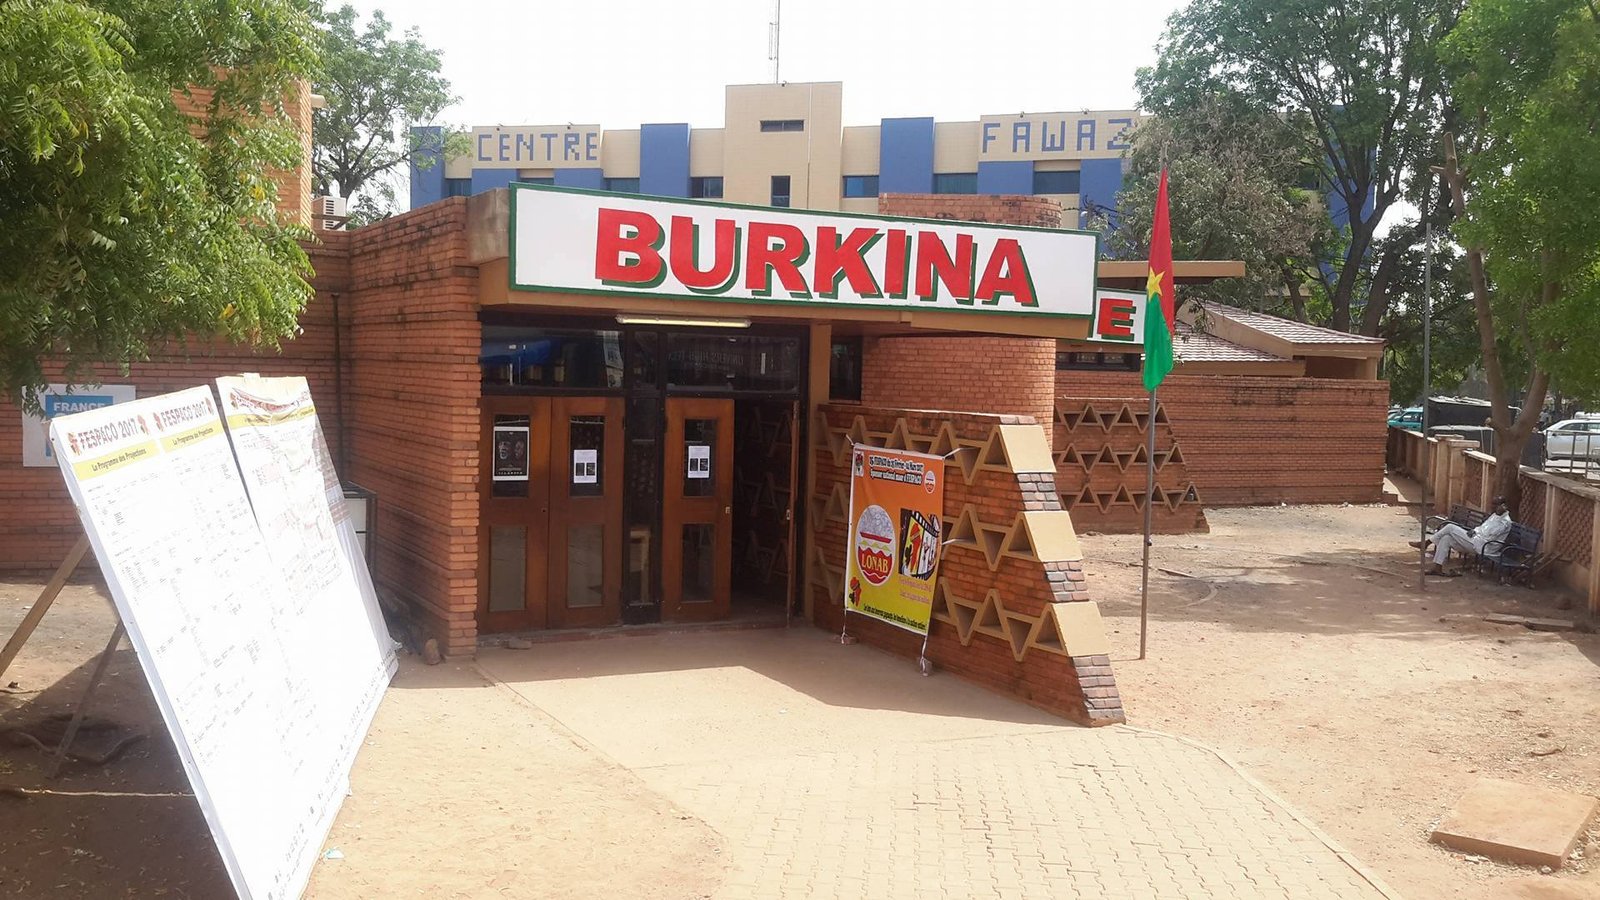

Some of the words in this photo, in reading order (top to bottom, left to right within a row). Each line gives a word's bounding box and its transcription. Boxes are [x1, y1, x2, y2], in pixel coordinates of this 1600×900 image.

[477, 132, 598, 162] CENTRE
[981, 118, 1133, 154] FAWAZ
[595, 207, 1040, 308] BURKINA
[1097, 297, 1137, 342] E
[160, 405, 193, 428] FESPACO
[192, 400, 207, 418] 2017
[77, 421, 119, 450] FESPACO
[117, 417, 138, 439] 2017
[97, 457, 119, 470] Programme
[861, 553, 889, 573] LONAB
